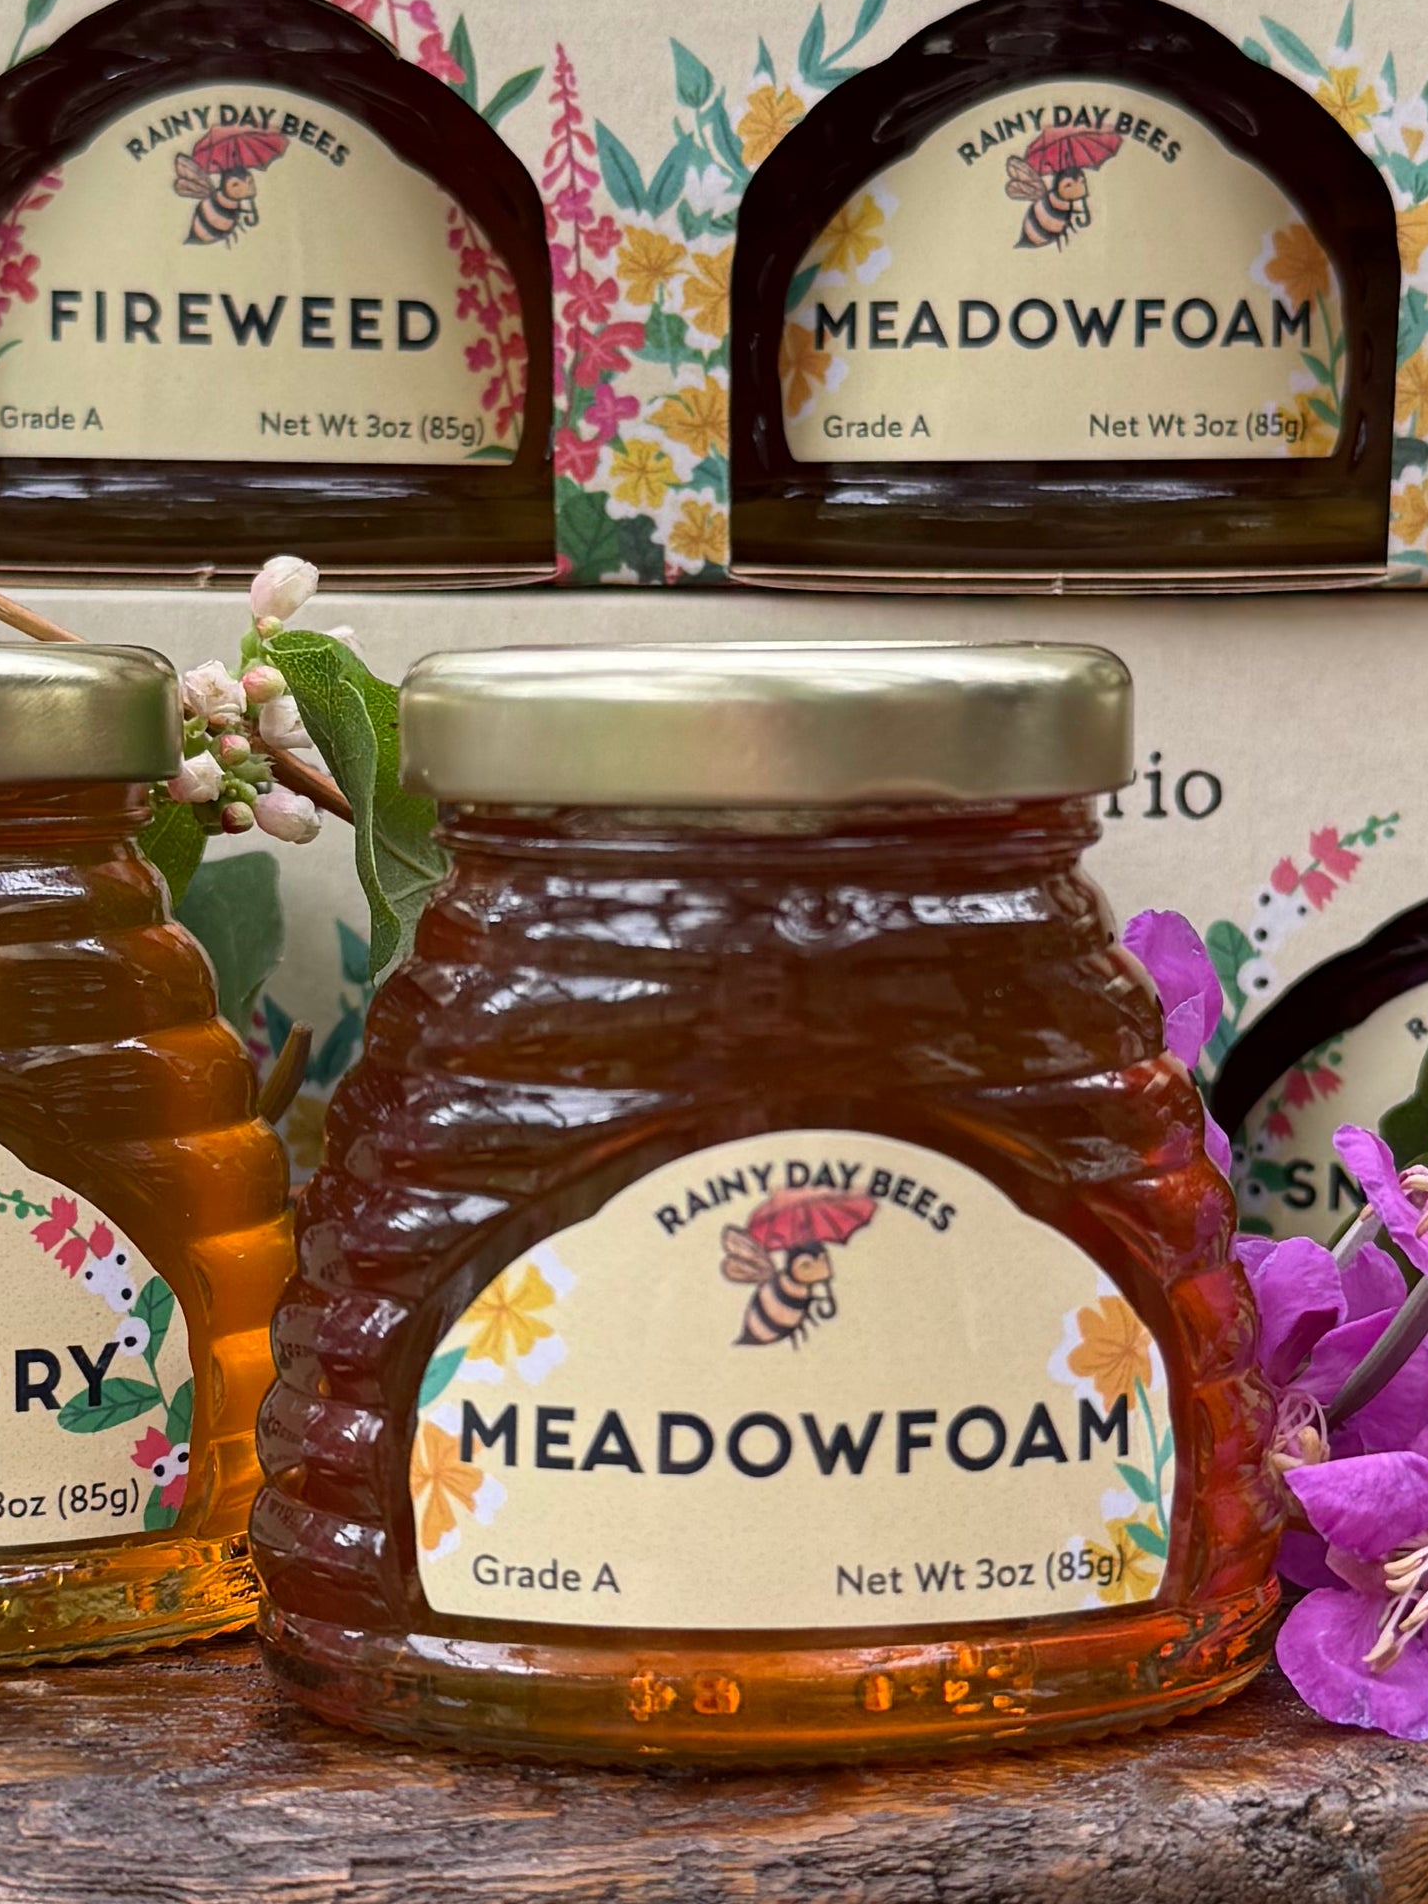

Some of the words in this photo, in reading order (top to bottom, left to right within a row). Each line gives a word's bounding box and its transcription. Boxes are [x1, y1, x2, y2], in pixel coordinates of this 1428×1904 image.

[126, 105, 212, 162] RAINY
[219, 104, 277, 130] DAY
[280, 112, 351, 167] BEES
[957, 108, 1045, 165] RAINY
[1052, 105, 1110, 129] DAY
[1114, 111, 1182, 164] BEES
[50, 290, 441, 351] FIREWEED
[814, 297, 1312, 351] MEADOWFOAM
[0, 405, 76, 431] Grade
[83, 406, 104, 431] A
[259, 411, 311, 437] Net
[318, 412, 359, 438] Wt
[366, 414, 413, 439] 3oz
[421, 415, 485, 446] (85g)
[823, 414, 903, 439] Grade
[910, 413, 932, 438] A
[1089, 413, 1139, 438] Net
[1147, 413, 1186, 437] Wt
[1193, 413, 1238, 437] 3oz
[1245, 412, 1308, 443] (85g)
[655, 1161, 773, 1235] RAINY
[787, 1160, 862, 1191] DAY
[870, 1169, 956, 1231] BEES
[459, 1394, 1130, 1478] MEADOWFOAM
[58, 1477, 139, 1521] (85g)
[472, 1553, 582, 1592] Grade
[591, 1561, 621, 1593] A
[835, 1564, 903, 1596] Net
[915, 1559, 966, 1592] Wt
[975, 1558, 1036, 1589] 3oz
[1045, 1544, 1126, 1590] (85g)
